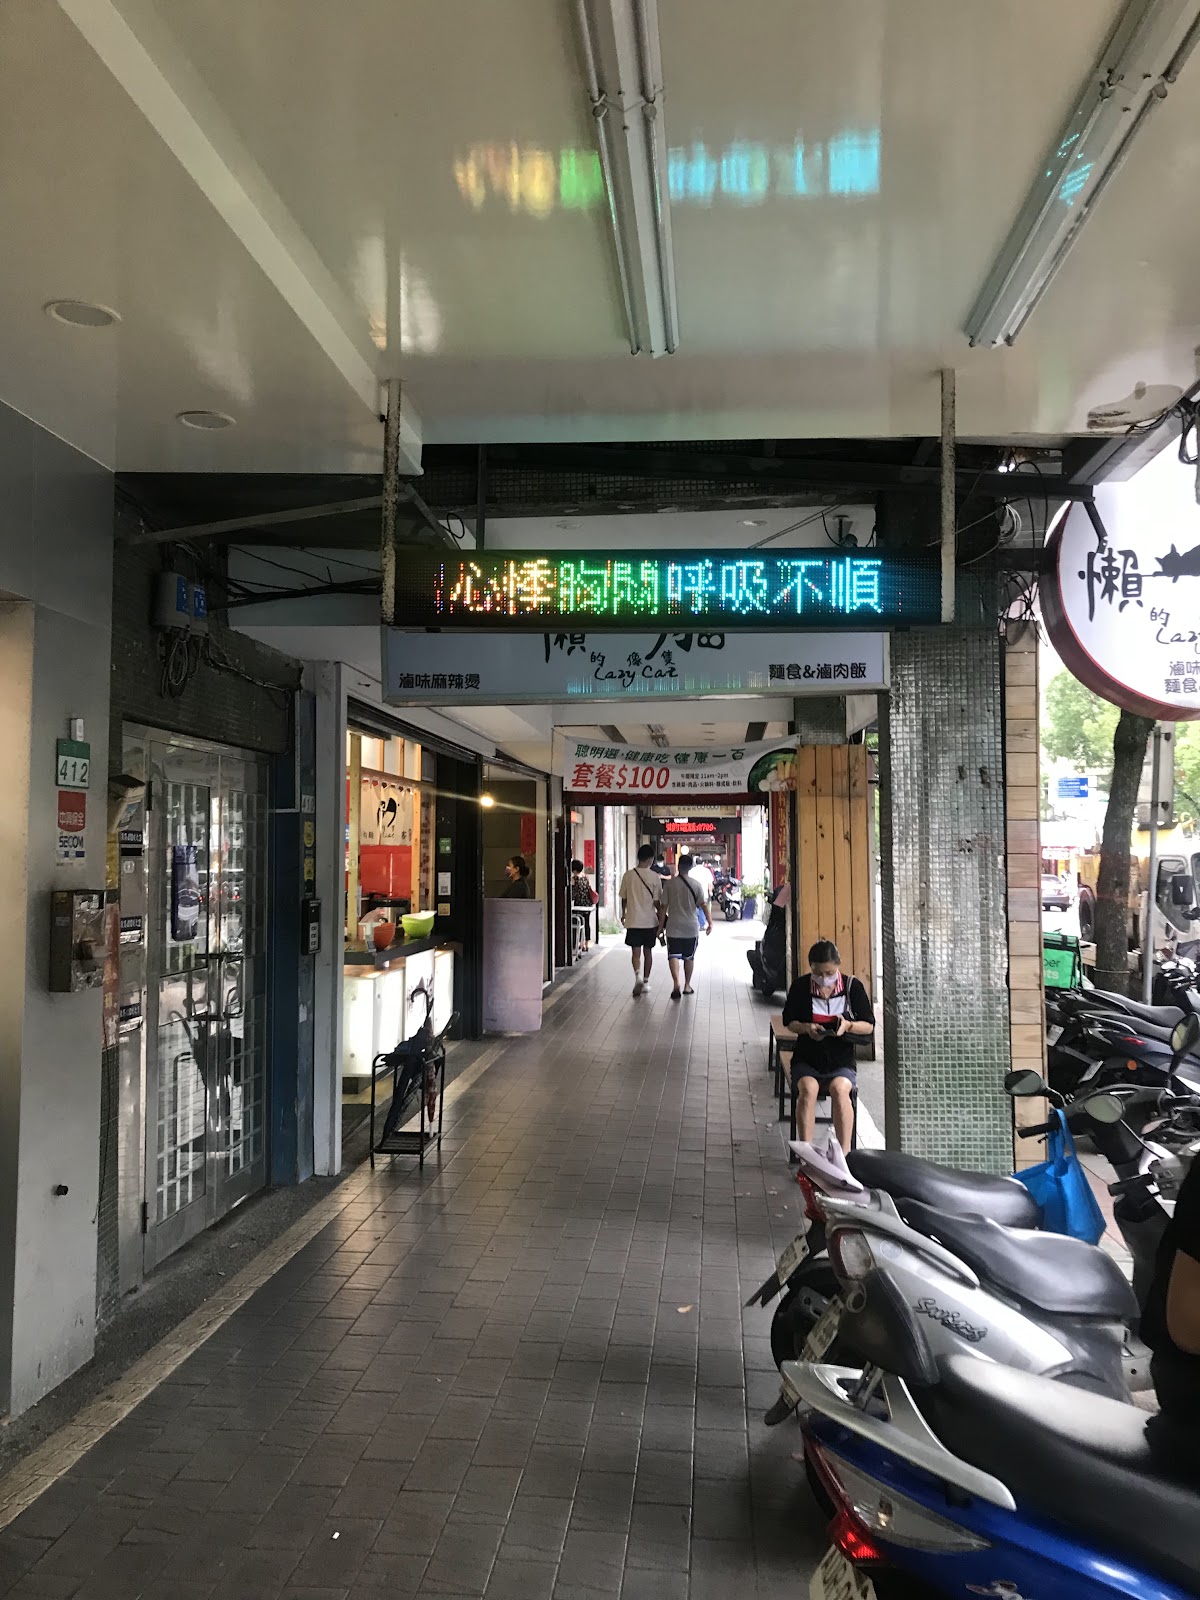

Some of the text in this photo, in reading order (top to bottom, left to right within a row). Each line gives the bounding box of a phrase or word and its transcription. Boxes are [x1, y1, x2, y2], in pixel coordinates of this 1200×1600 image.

[1077, 547, 1143, 622] 懶
[1150, 607, 1170, 627] 的
[768, 661, 866, 680] 麵食&滷肉飯
[398, 672, 480, 691] 滷味麻辣燙
[1164, 677, 1200, 695] 麵食
[59, 759, 88, 783] 412
[571, 762, 670, 790] 套餐$100
[59, 835, 84, 848] SECOM
